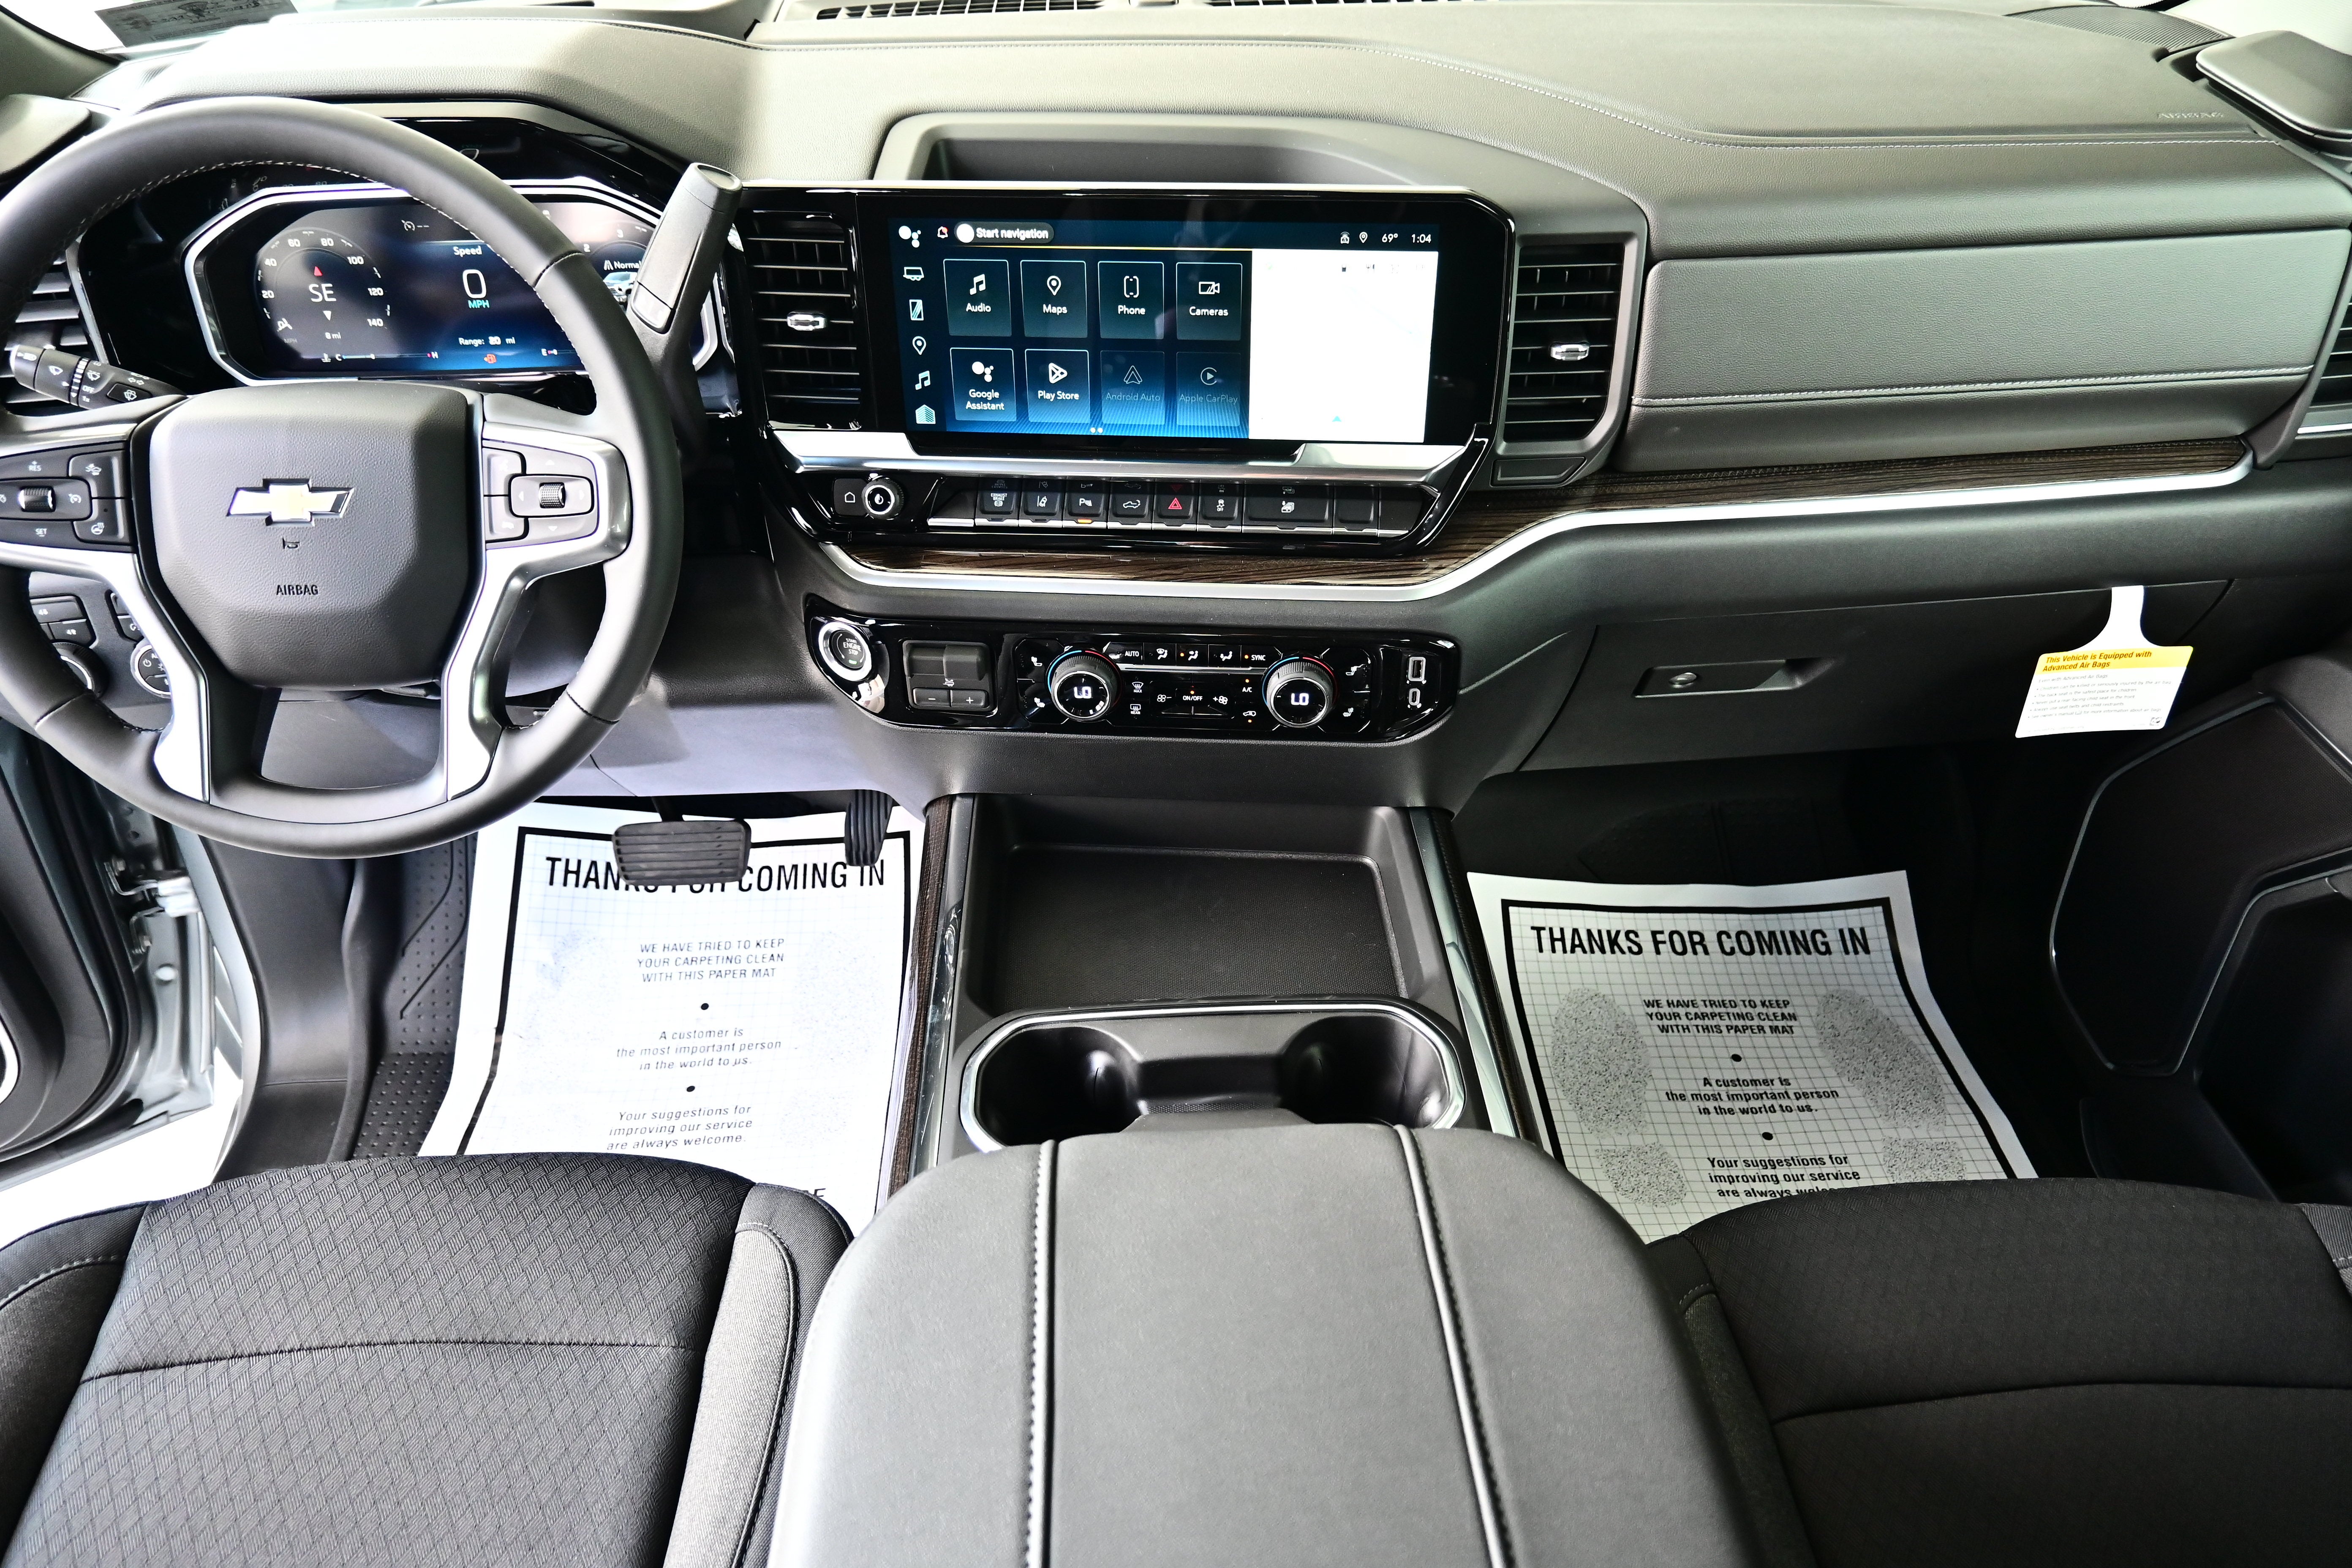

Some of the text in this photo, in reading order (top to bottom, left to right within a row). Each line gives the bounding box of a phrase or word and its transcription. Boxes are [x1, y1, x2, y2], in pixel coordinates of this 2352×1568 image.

[976, 228, 1048, 240] Start navigation
[1382, 233, 1398, 243] 69°
[1411, 234, 1431, 243] 1:04
[288, 239, 301, 247] 60
[321, 238, 334, 247] 80
[584, 243, 590, 252] 2
[453, 245, 482, 257] Speed
[347, 256, 364, 265] 100
[463, 270, 487, 298] 0
[262, 290, 274, 299] 20
[308, 283, 337, 302] SE
[368, 288, 384, 296] 120
[468, 299, 490, 308] MPH
[966, 303, 991, 312] Audio
[1043, 304, 1067, 315] Maps
[1118, 305, 1146, 315] Phone
[1189, 306, 1228, 316] Cameras
[367, 318, 384, 327] 140
[459, 338, 485, 347] Range:
[969, 389, 999, 400] Google
[1038, 391, 1079, 400] Play Store
[1179, 394, 1238, 405] Apple CarPlay
[966, 402, 1004, 410] Assistant
[276, 585, 318, 595] AIRBAG
[843, 642, 862, 652] ENGINE
[2099, 652, 2134, 660] Equipped
[2043, 663, 2078, 672] Advanced
[546, 857, 884, 893] THAN COMING IN
[640, 939, 784, 953] WE HAVE TRIED TO KEEP
[1531, 926, 1870, 956] THANKS FOR COMING IN
[637, 953, 784, 968] YOUR CARPETING CLEAN
[642, 968, 776, 983] WITH THIS PAPER MAT
[1644, 1000, 1789, 1008] WE HAVE TRIED TO KEEP
[1647, 1012, 1797, 1021] YOUR CARPETING CLEAN
[659, 1028, 743, 1040] A customer is
[1657, 1025, 1794, 1034] WITH THIS PAPER MAT
[617, 1040, 781, 1057] the most important person
[640, 1057, 752, 1070] in the world to us.
[1704, 1077, 1791, 1087] A customer is
[1666, 1090, 1839, 1102] the most important person
[619, 1105, 751, 1121] Your suggestions for
[1699, 1106, 1710, 1115] in
[1714, 1106, 1734, 1115] the
[1739, 1104, 1775, 1115] world
[1780, 1104, 1793, 1113] to
[609, 1119, 752, 1136] improving our service
[607, 1135, 746, 1150] are always welcome.
[1707, 1155, 1848, 1169] Your suggestions for
[1709, 1170, 1860, 1184] improving our service
[1717, 1189, 1740, 1197] are
[1744, 1188, 1792, 1198] always
